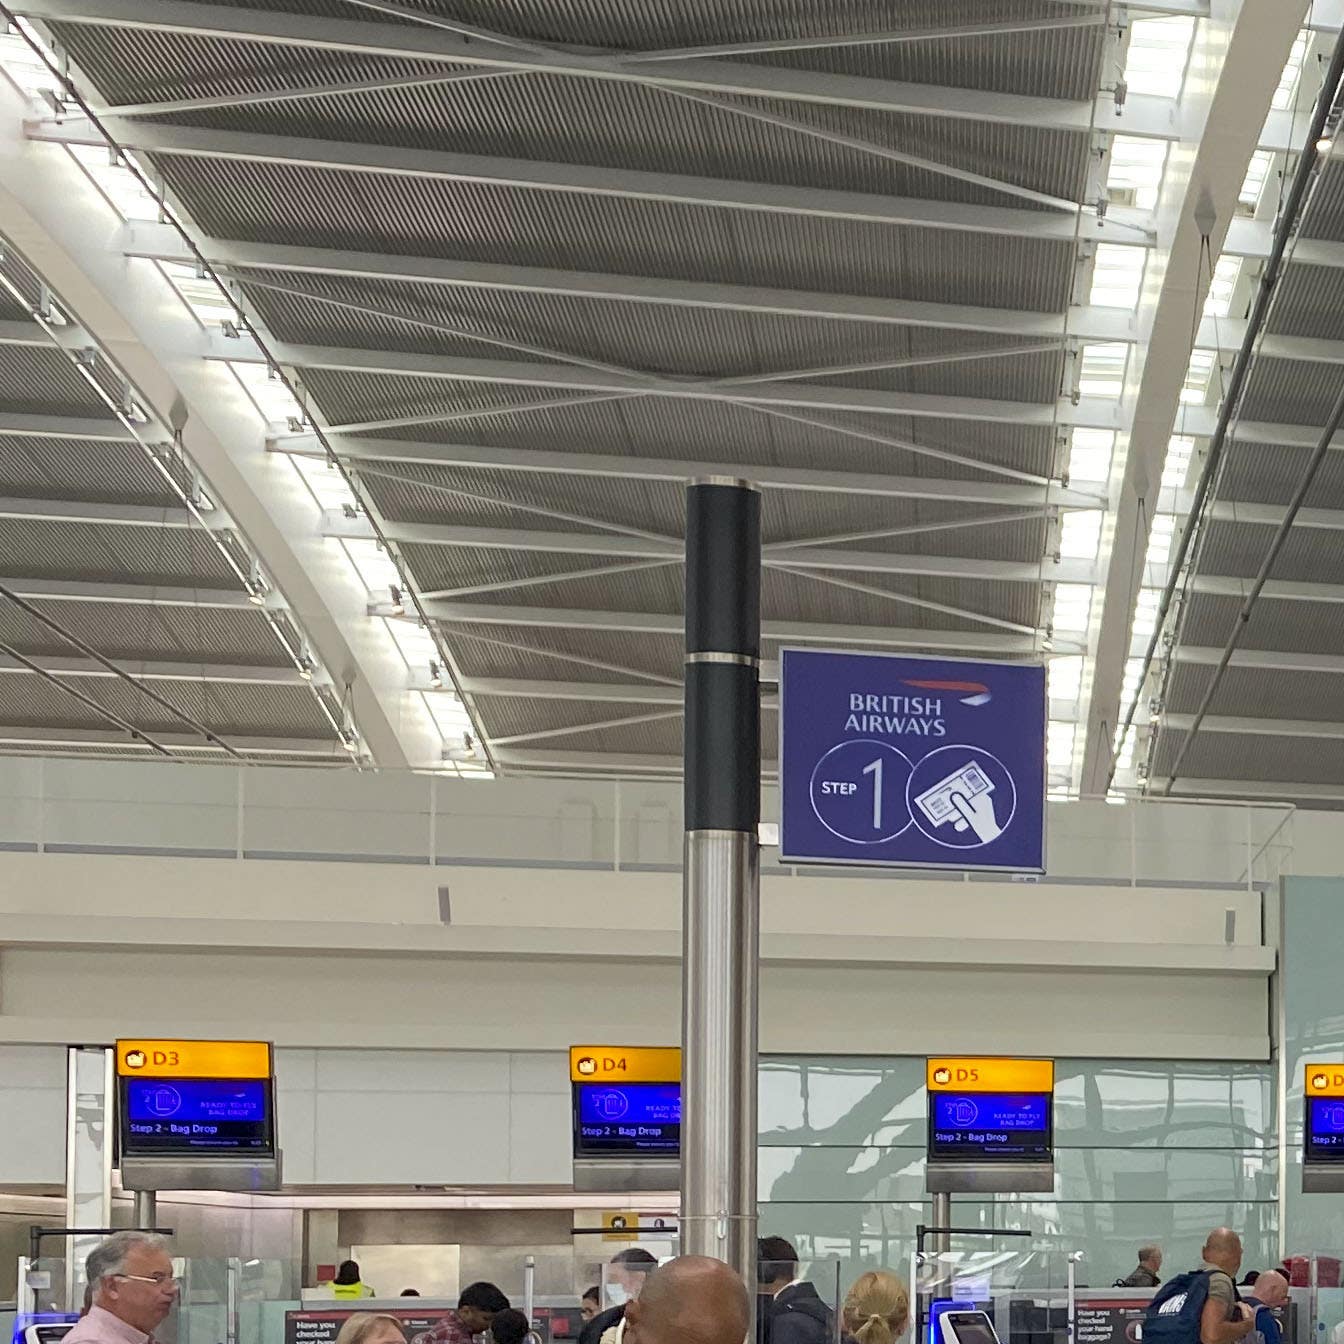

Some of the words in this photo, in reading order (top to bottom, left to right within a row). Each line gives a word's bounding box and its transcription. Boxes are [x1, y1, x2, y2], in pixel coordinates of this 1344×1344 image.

[850, 693, 941, 715] BRITISH
[844, 713, 946, 737] AIRWAYS
[821, 781, 857, 795] STEP
[862, 757, 882, 829] 1
[152, 1052, 179, 1067] D3
[602, 1058, 626, 1072] D4
[956, 1069, 979, 1083] D5
[130, 1124, 153, 1134] Step
[170, 1124, 190, 1134] Bag
[192, 1124, 218, 1134] Drop
[582, 1127, 603, 1136] Step
[618, 1127, 636, 1136] Bag
[638, 1127, 661, 1136] Drop
[935, 1133, 954, 1142] Step
[968, 1133, 984, 1142] Bag
[986, 1133, 1008, 1142] Drop
[1312, 1136, 1330, 1145] Step
[296, 1321, 317, 1329] Have
[319, 1322, 336, 1332] you
[296, 1330, 330, 1338] checked
